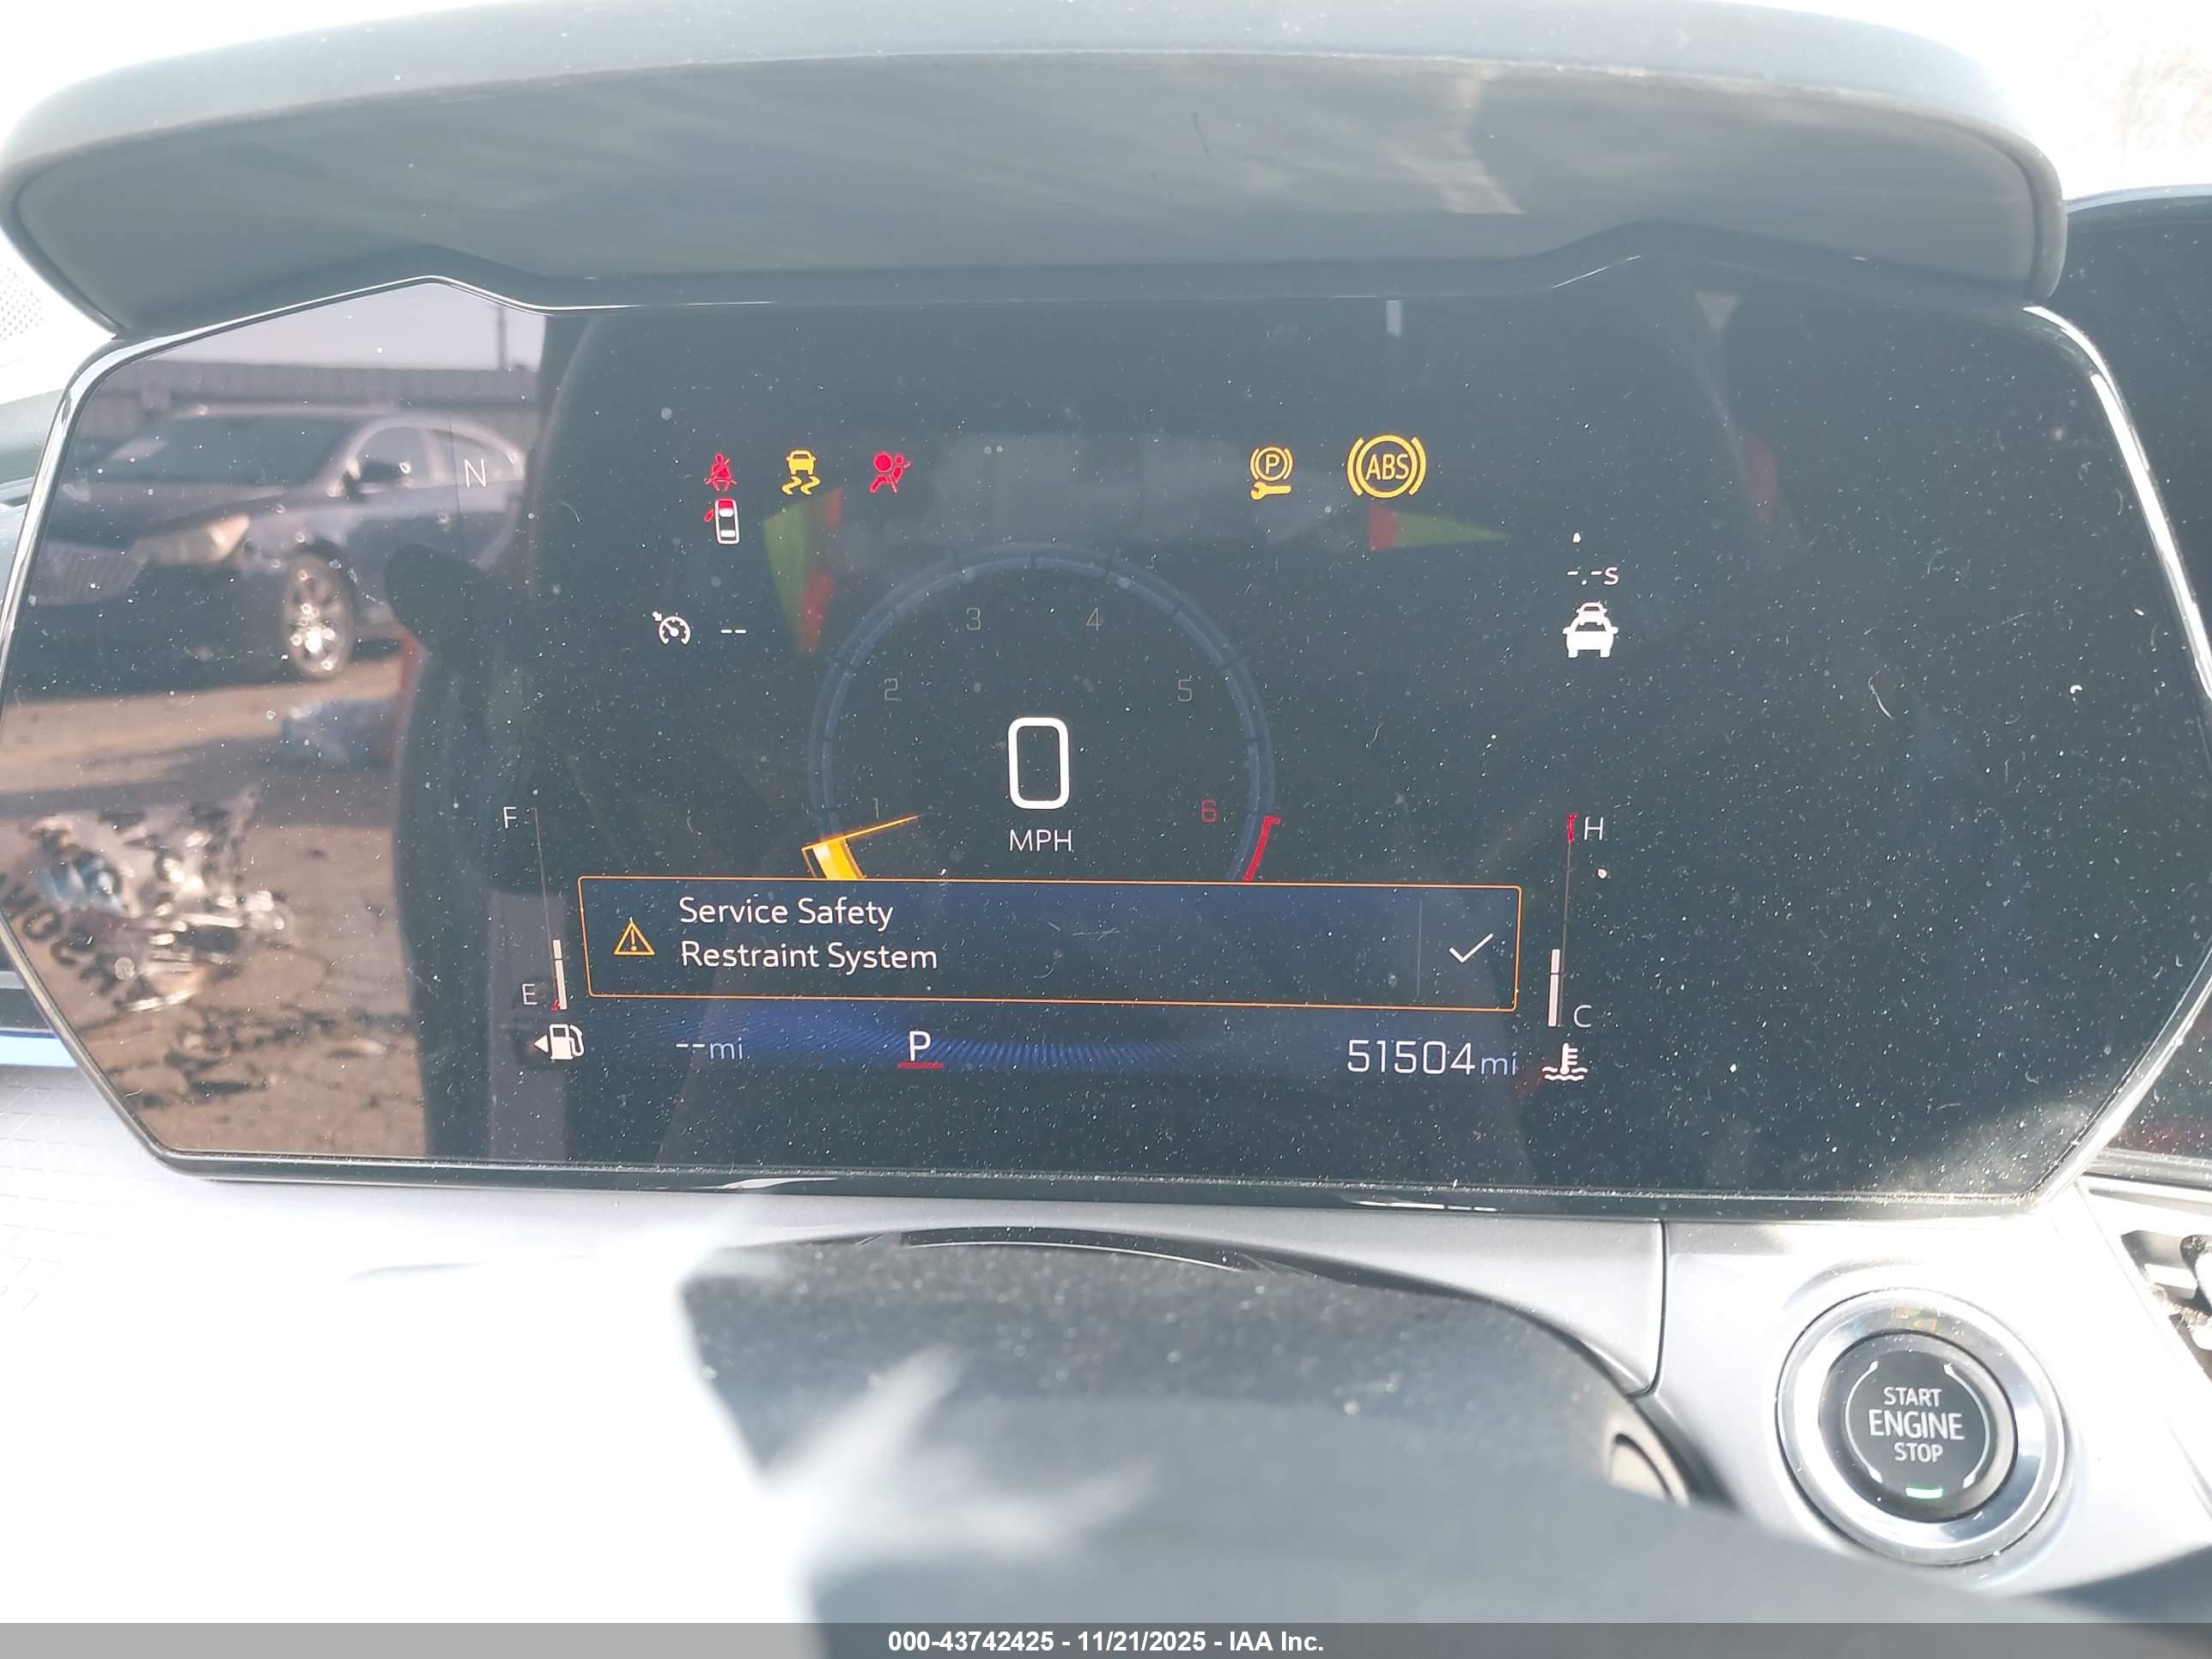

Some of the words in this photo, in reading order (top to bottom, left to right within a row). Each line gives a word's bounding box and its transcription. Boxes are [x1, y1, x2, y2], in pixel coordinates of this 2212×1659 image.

[465, 459, 486, 487] N
[1265, 455, 1280, 474] P
[1365, 454, 1410, 481] ABS
[967, 608, 981, 630] 3
[1086, 608, 1102, 631] 4
[884, 678, 898, 701] 2
[1177, 680, 1193, 702] 5
[1008, 718, 1069, 809] 0
[503, 807, 516, 829] F
[1201, 800, 1217, 822] 6
[1584, 817, 1603, 840] H
[1010, 830, 1071, 851] MPH
[680, 896, 787, 923] Service
[799, 896, 893, 932] Safety
[682, 941, 819, 967] Restraint
[828, 942, 936, 975] System
[522, 984, 537, 1005] E
[1574, 1005, 1591, 1027] C
[909, 1031, 930, 1060] P
[1883, 1386, 1942, 1408] START
[1868, 1408, 1965, 1441] ENGINE
[1894, 1443, 1942, 1462] STOP
